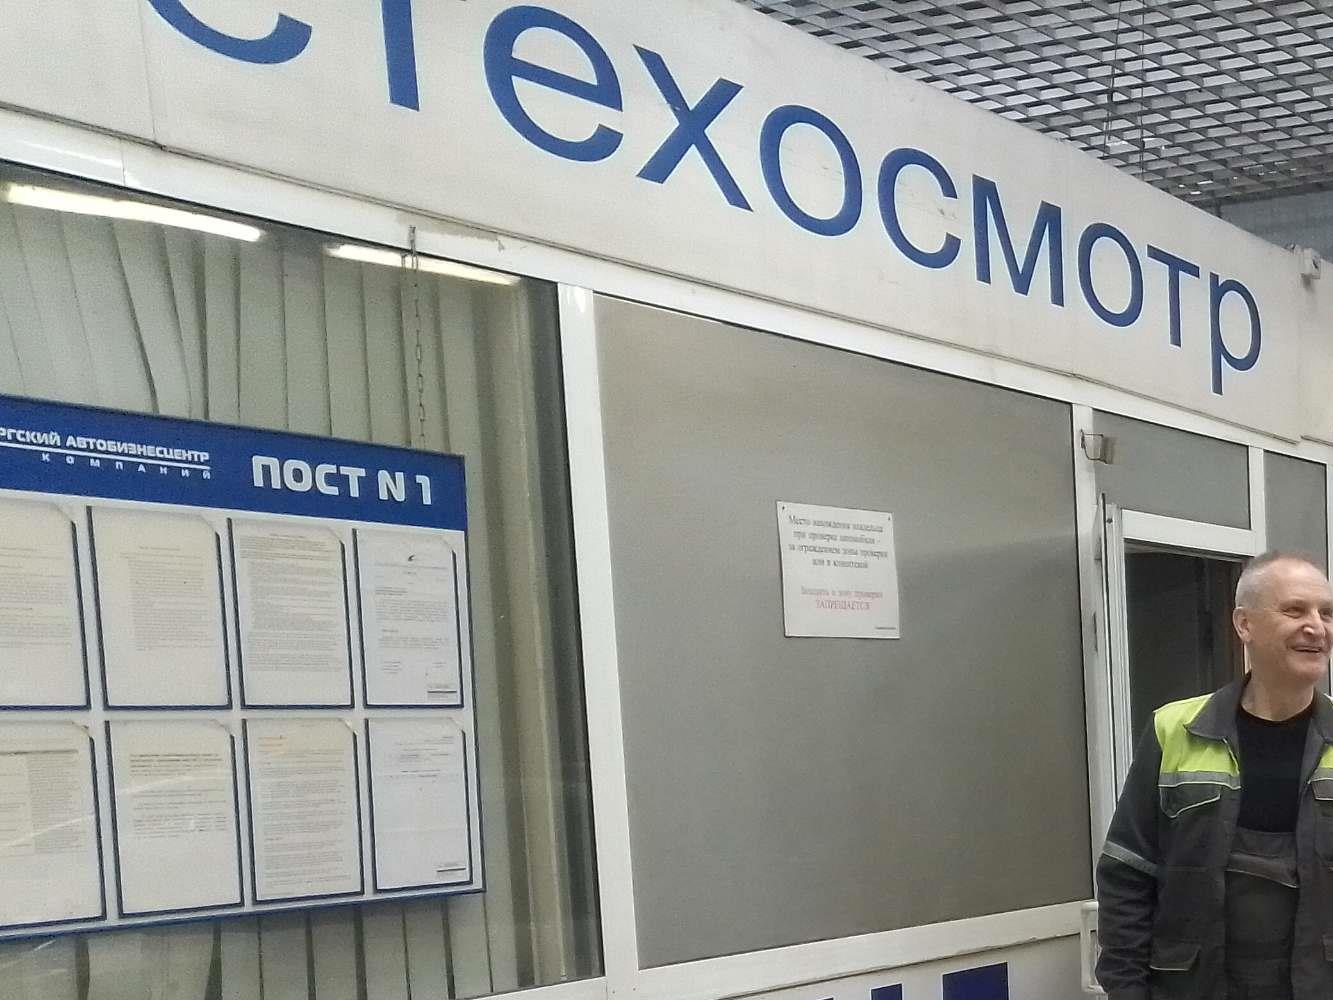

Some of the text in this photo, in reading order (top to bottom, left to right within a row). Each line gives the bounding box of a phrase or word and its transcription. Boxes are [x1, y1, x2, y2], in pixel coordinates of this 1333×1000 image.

[66, 435, 209, 463] АВТОБИЗНЕСЦЕНТР
[252, 455, 366, 497] ПОСТ
[415, 474, 432, 505] 1
